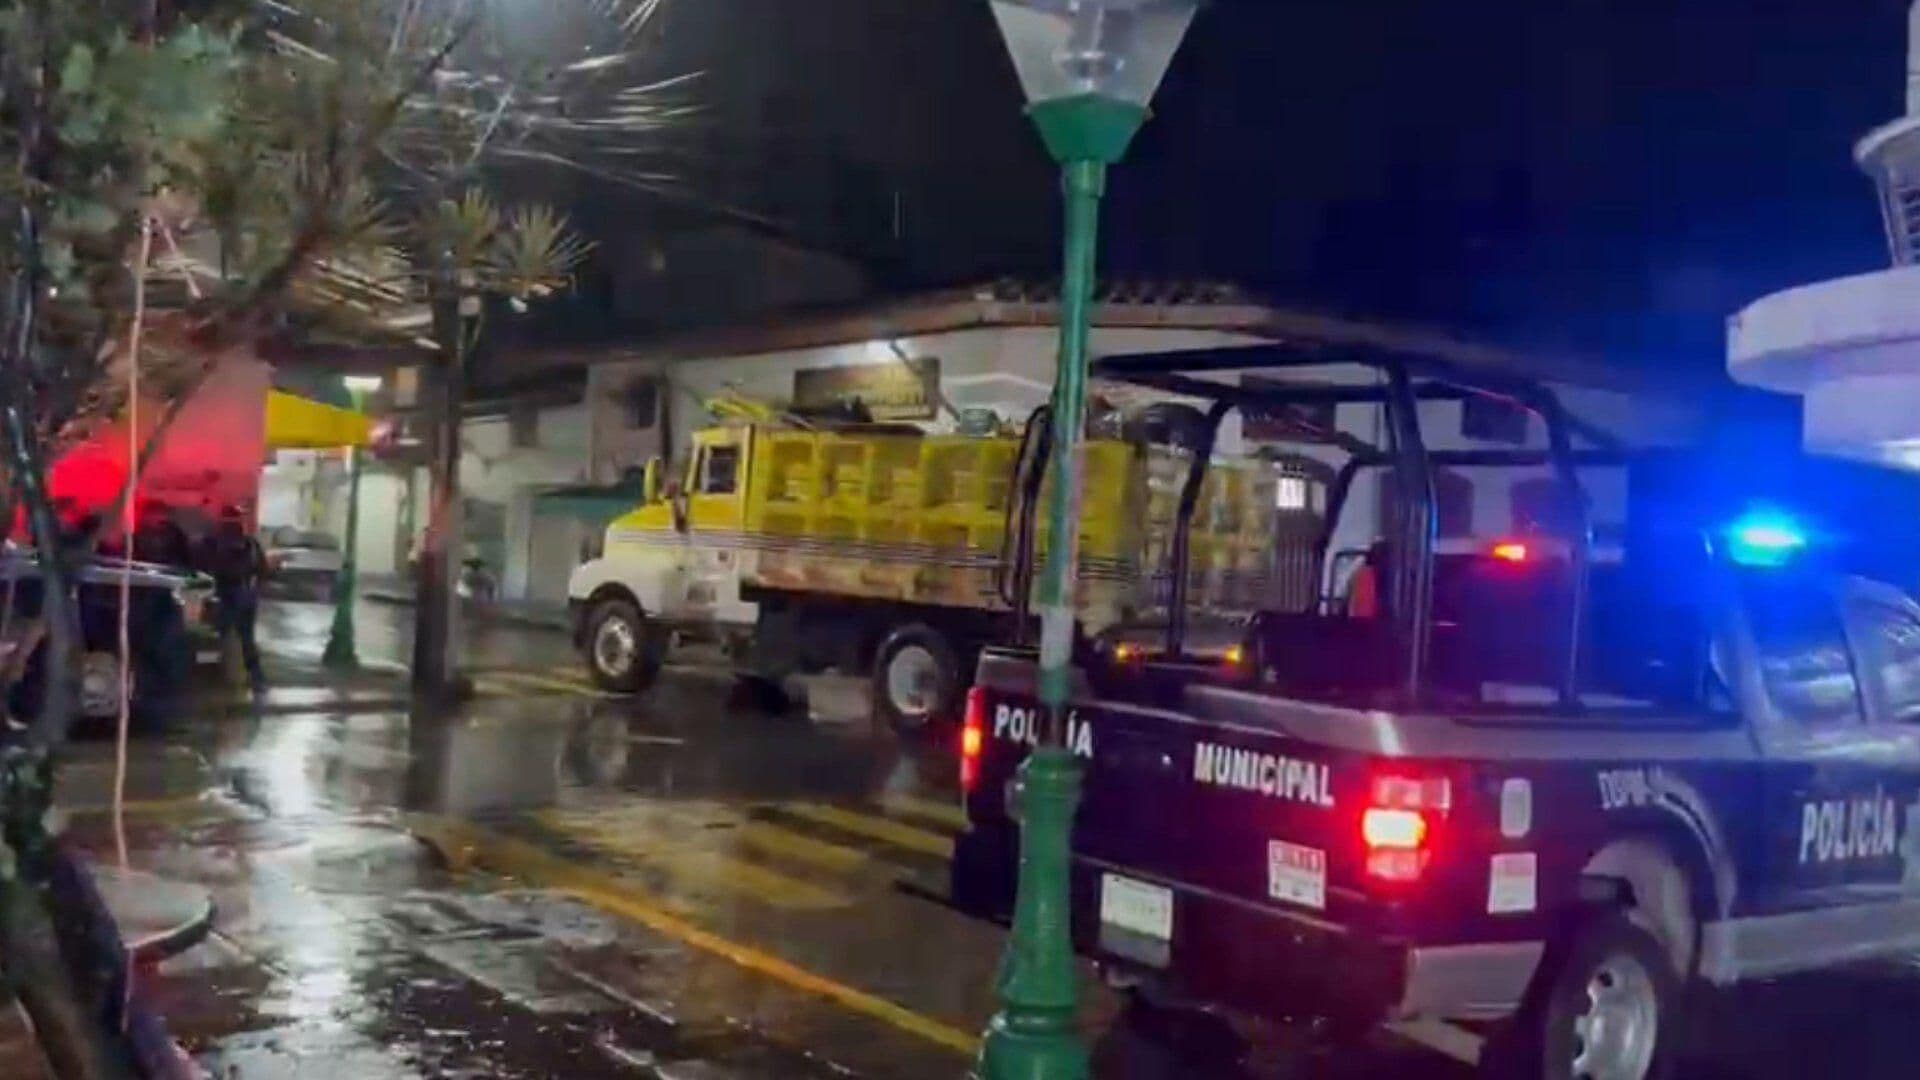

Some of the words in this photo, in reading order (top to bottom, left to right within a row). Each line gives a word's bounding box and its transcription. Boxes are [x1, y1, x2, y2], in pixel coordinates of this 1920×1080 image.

[993, 703, 1093, 758] POLÍA
[1194, 742, 1335, 807] MUNICIPAL
[1799, 783, 1896, 864] POLICÍA
